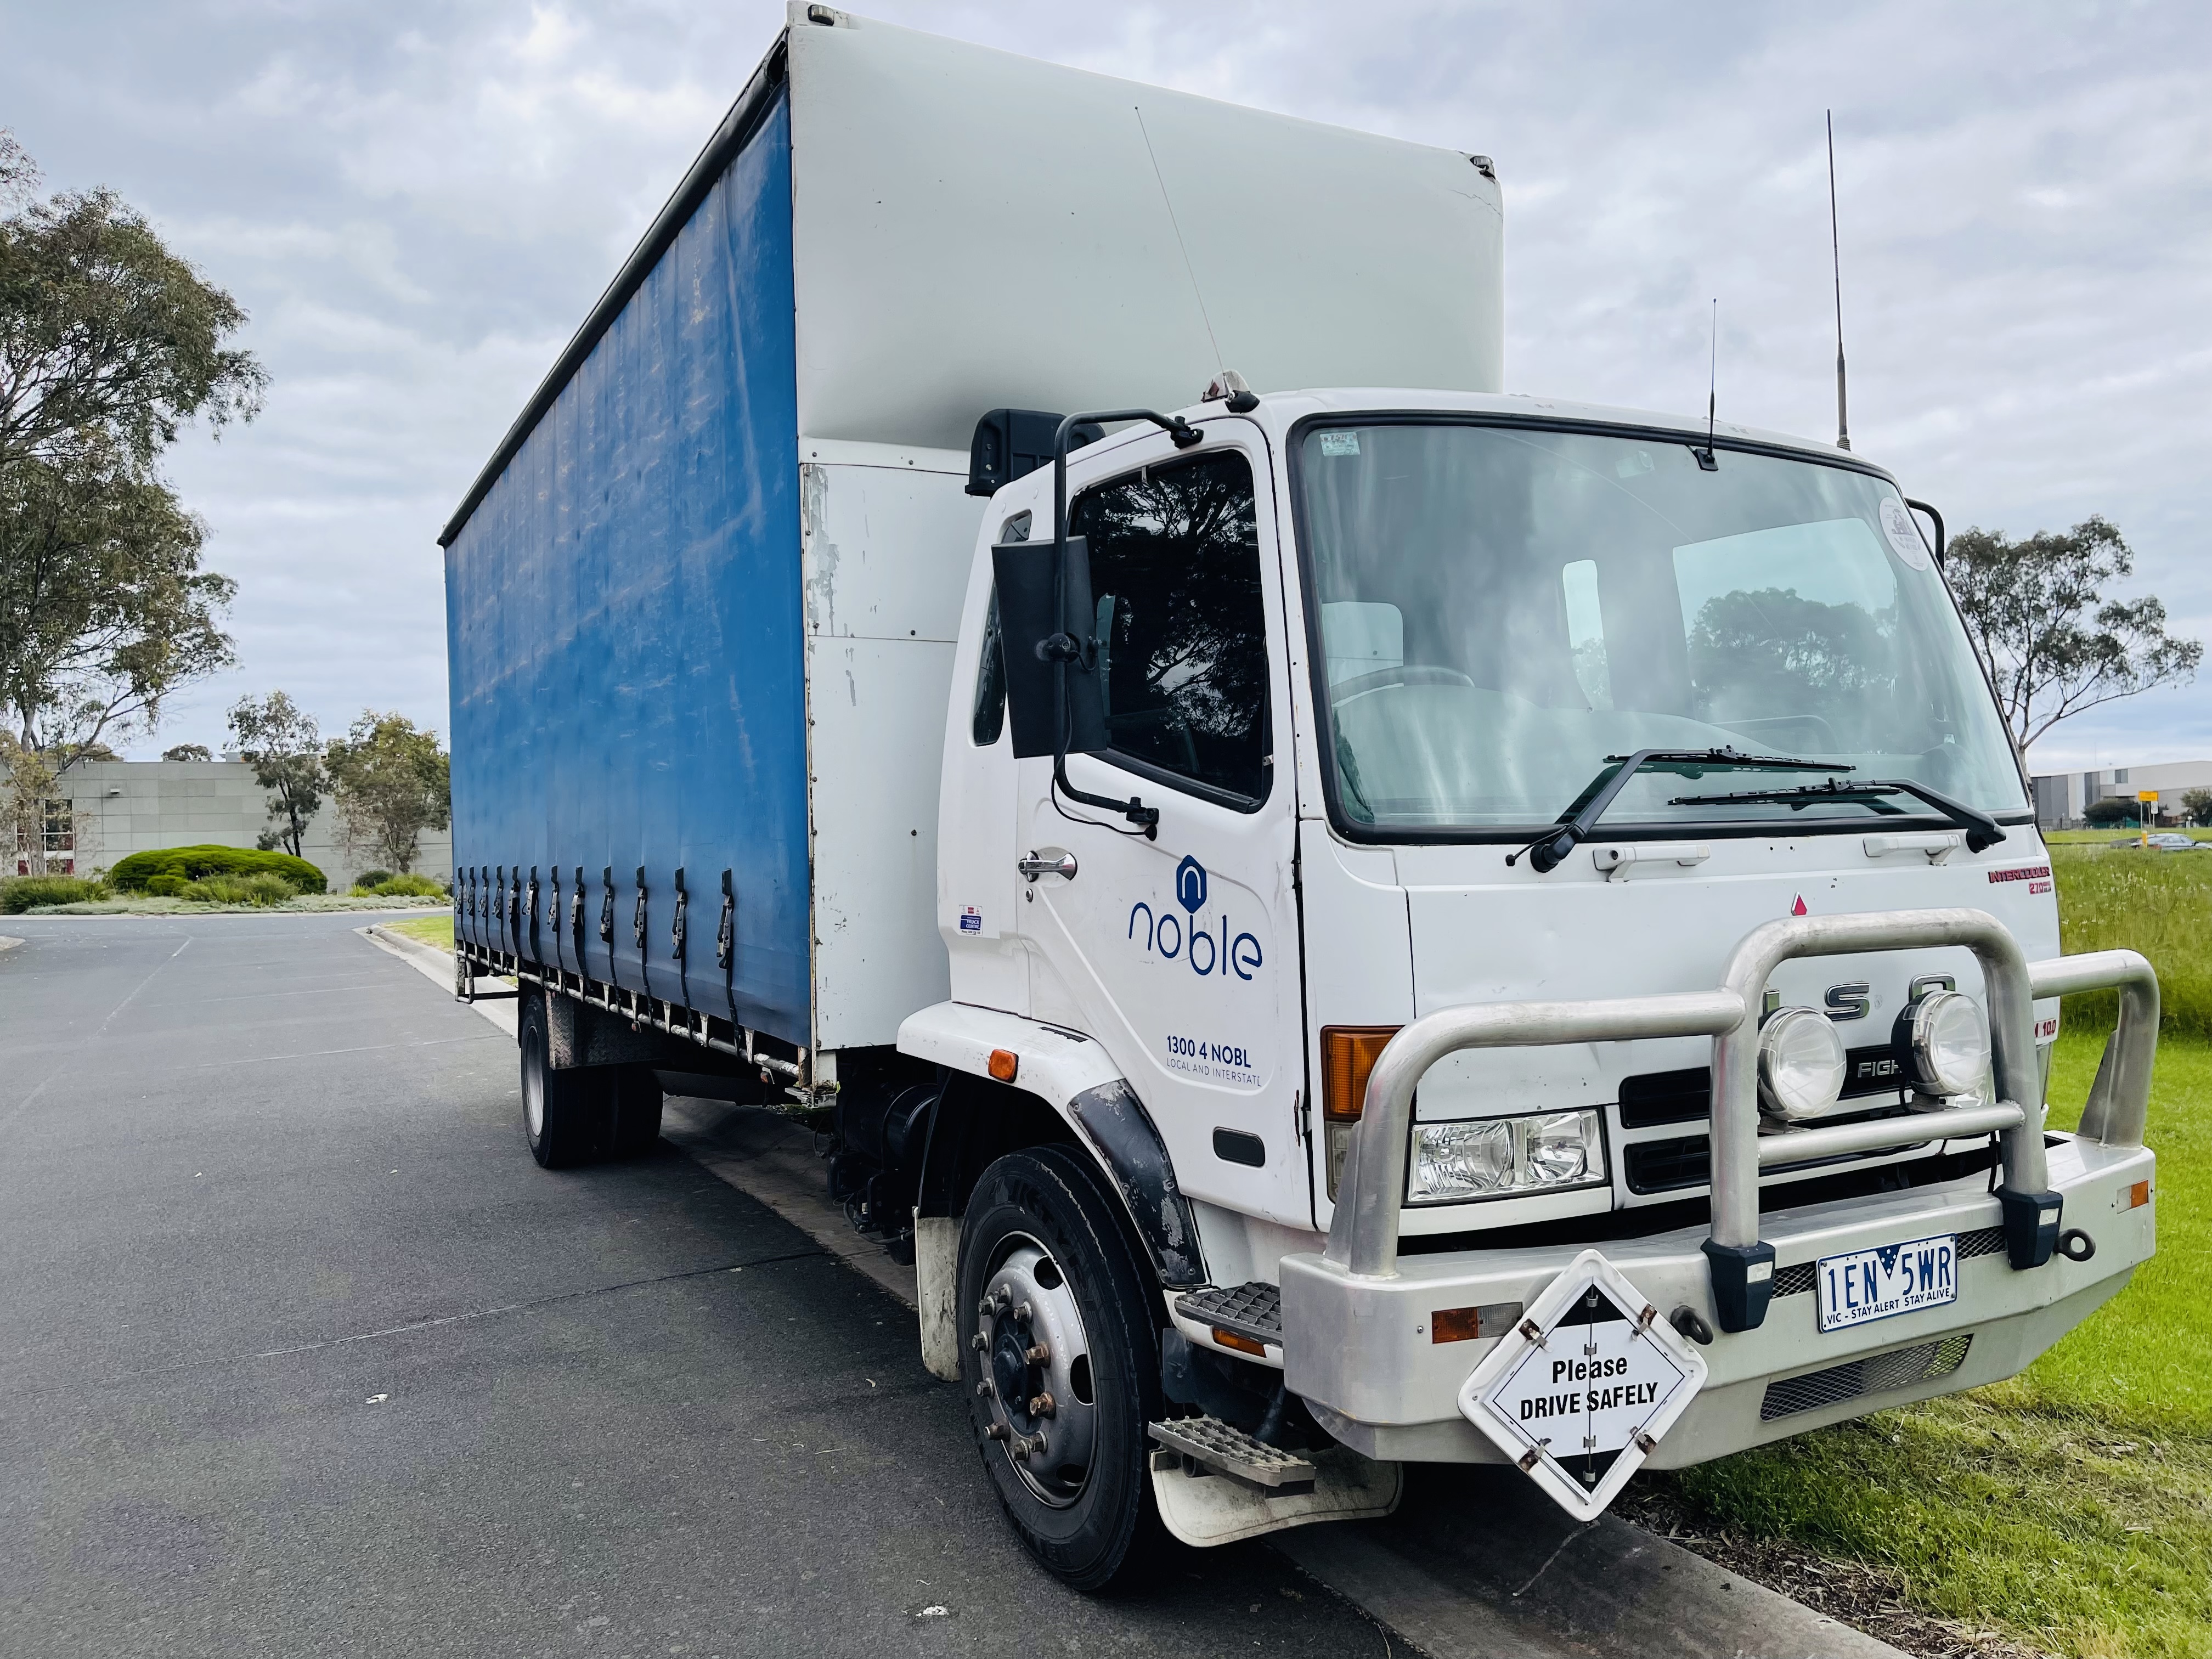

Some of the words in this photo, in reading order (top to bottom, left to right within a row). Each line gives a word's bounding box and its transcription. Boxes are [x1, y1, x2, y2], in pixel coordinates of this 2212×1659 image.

[2029, 882, 2044, 895] 270
[1128, 902, 1262, 980] noble
[1167, 1035, 1195, 1057] 1300
[1199, 1042, 1207, 1059] 4
[1211, 1043, 1251, 1068] NOBL
[1167, 1057, 1190, 1071] LOCAL
[1193, 1064, 1210, 1075] AND
[1858, 1059, 1900, 1078] FIGH
[1828, 1260, 1877, 1312] 1EN
[1901, 1246, 1951, 1295] 5WR
[1827, 1313, 1841, 1324] VIC
[1852, 1306, 1872, 1319] STAY
[1874, 1299, 1899, 1313] ALERT
[1904, 1293, 1925, 1306] STAY
[1927, 1288, 1950, 1301] ALIVE
[1553, 1357, 1627, 1384] Please
[1521, 1392, 1581, 1420] DRIVE
[1587, 1382, 1658, 1412] SAFELY
